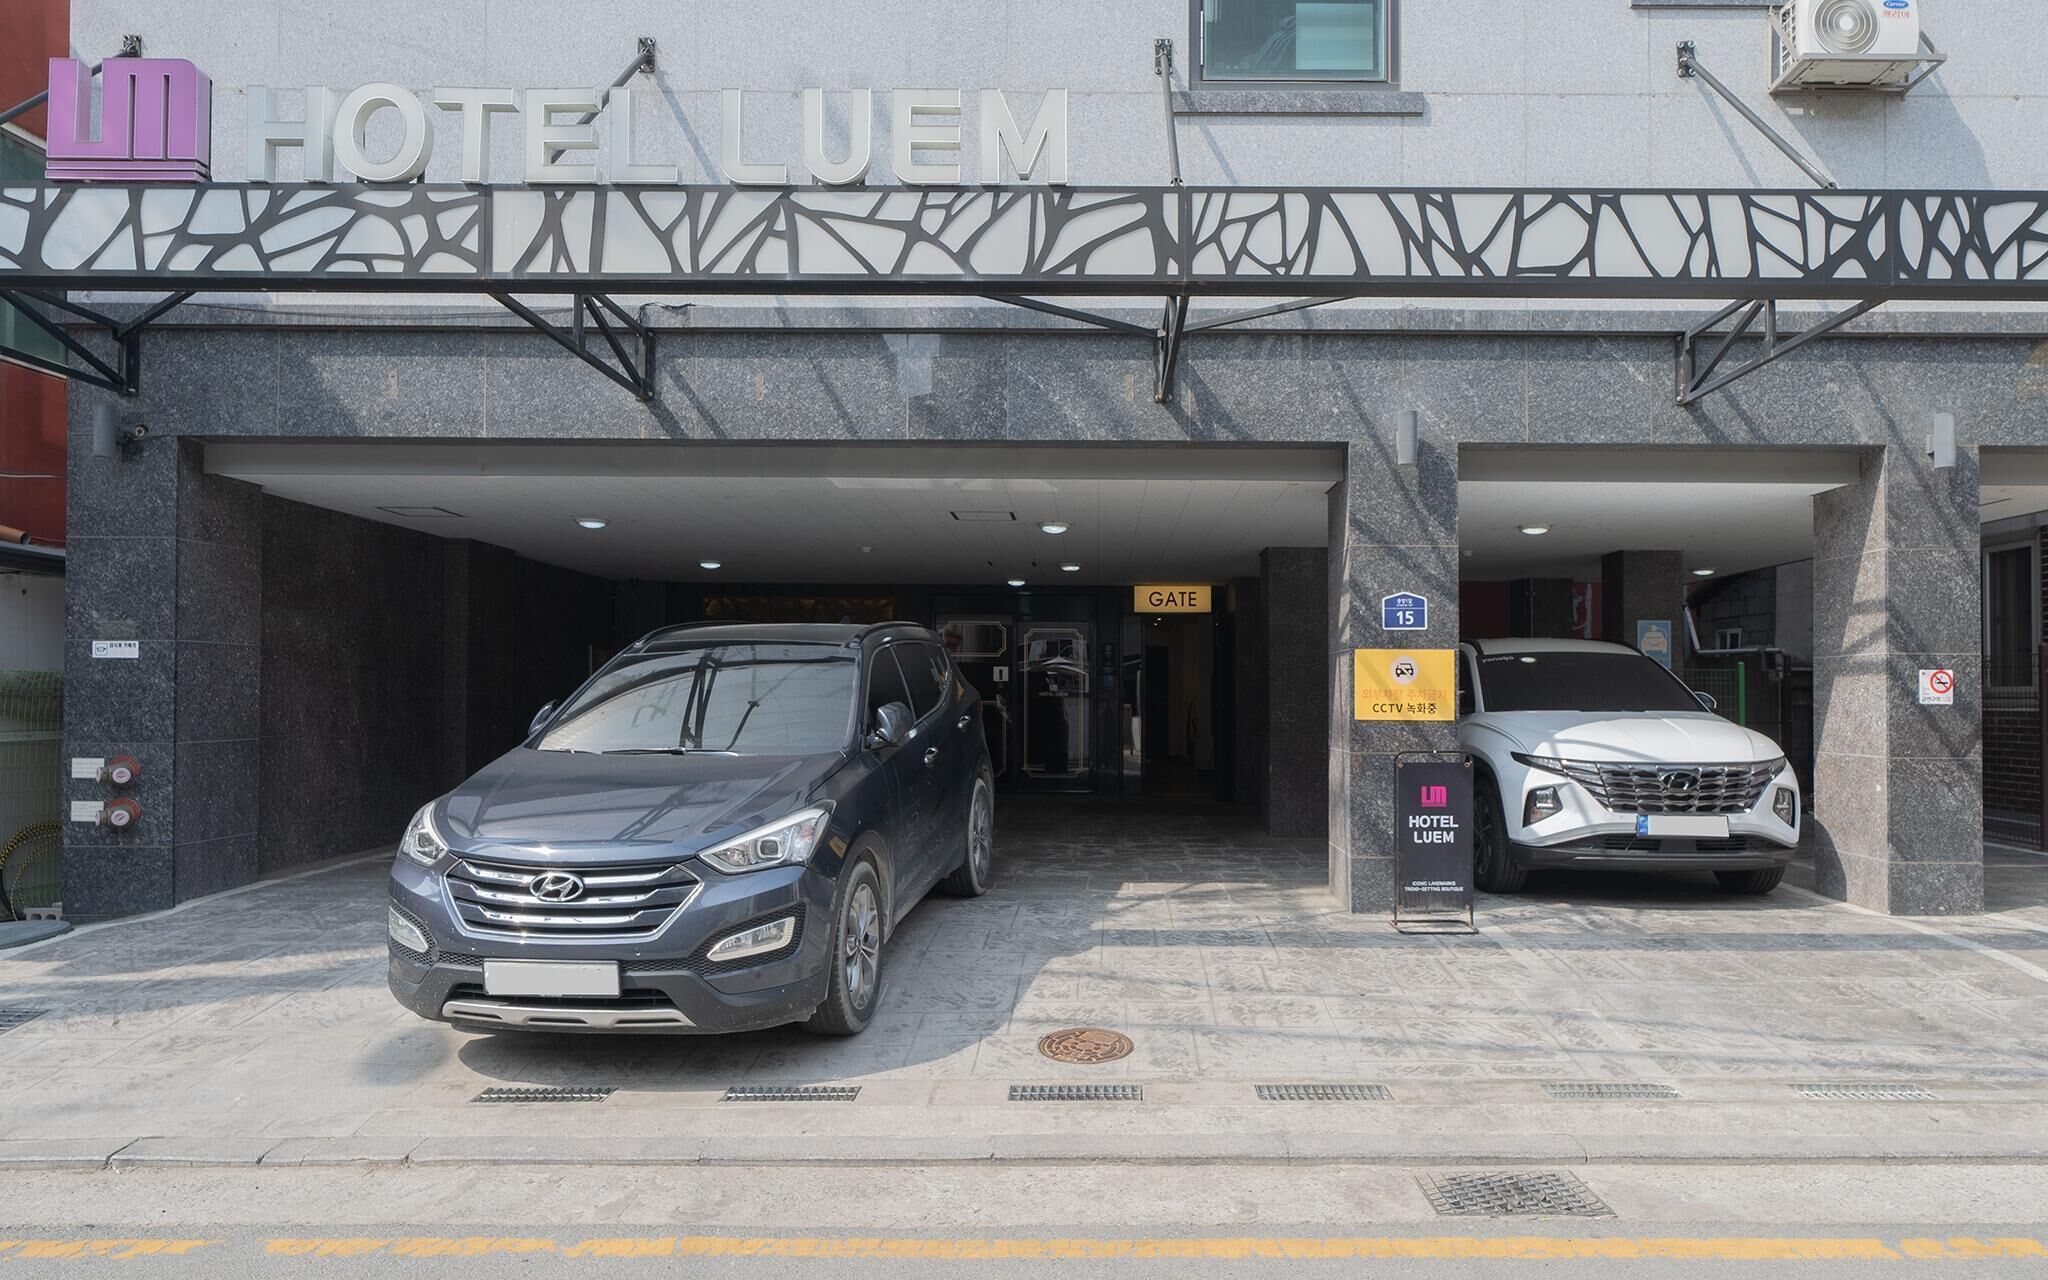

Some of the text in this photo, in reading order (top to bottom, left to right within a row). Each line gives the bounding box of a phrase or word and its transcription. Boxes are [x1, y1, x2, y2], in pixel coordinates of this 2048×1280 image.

[246, 81, 1068, 185] HOTEL LUEM
[1148, 591, 1197, 607] GATE
[1396, 610, 1414, 625] 15
[1372, 702, 1437, 714] CCTV 녹화중
[1409, 815, 1459, 828] HOTEL
[1413, 831, 1455, 844] LUEM
